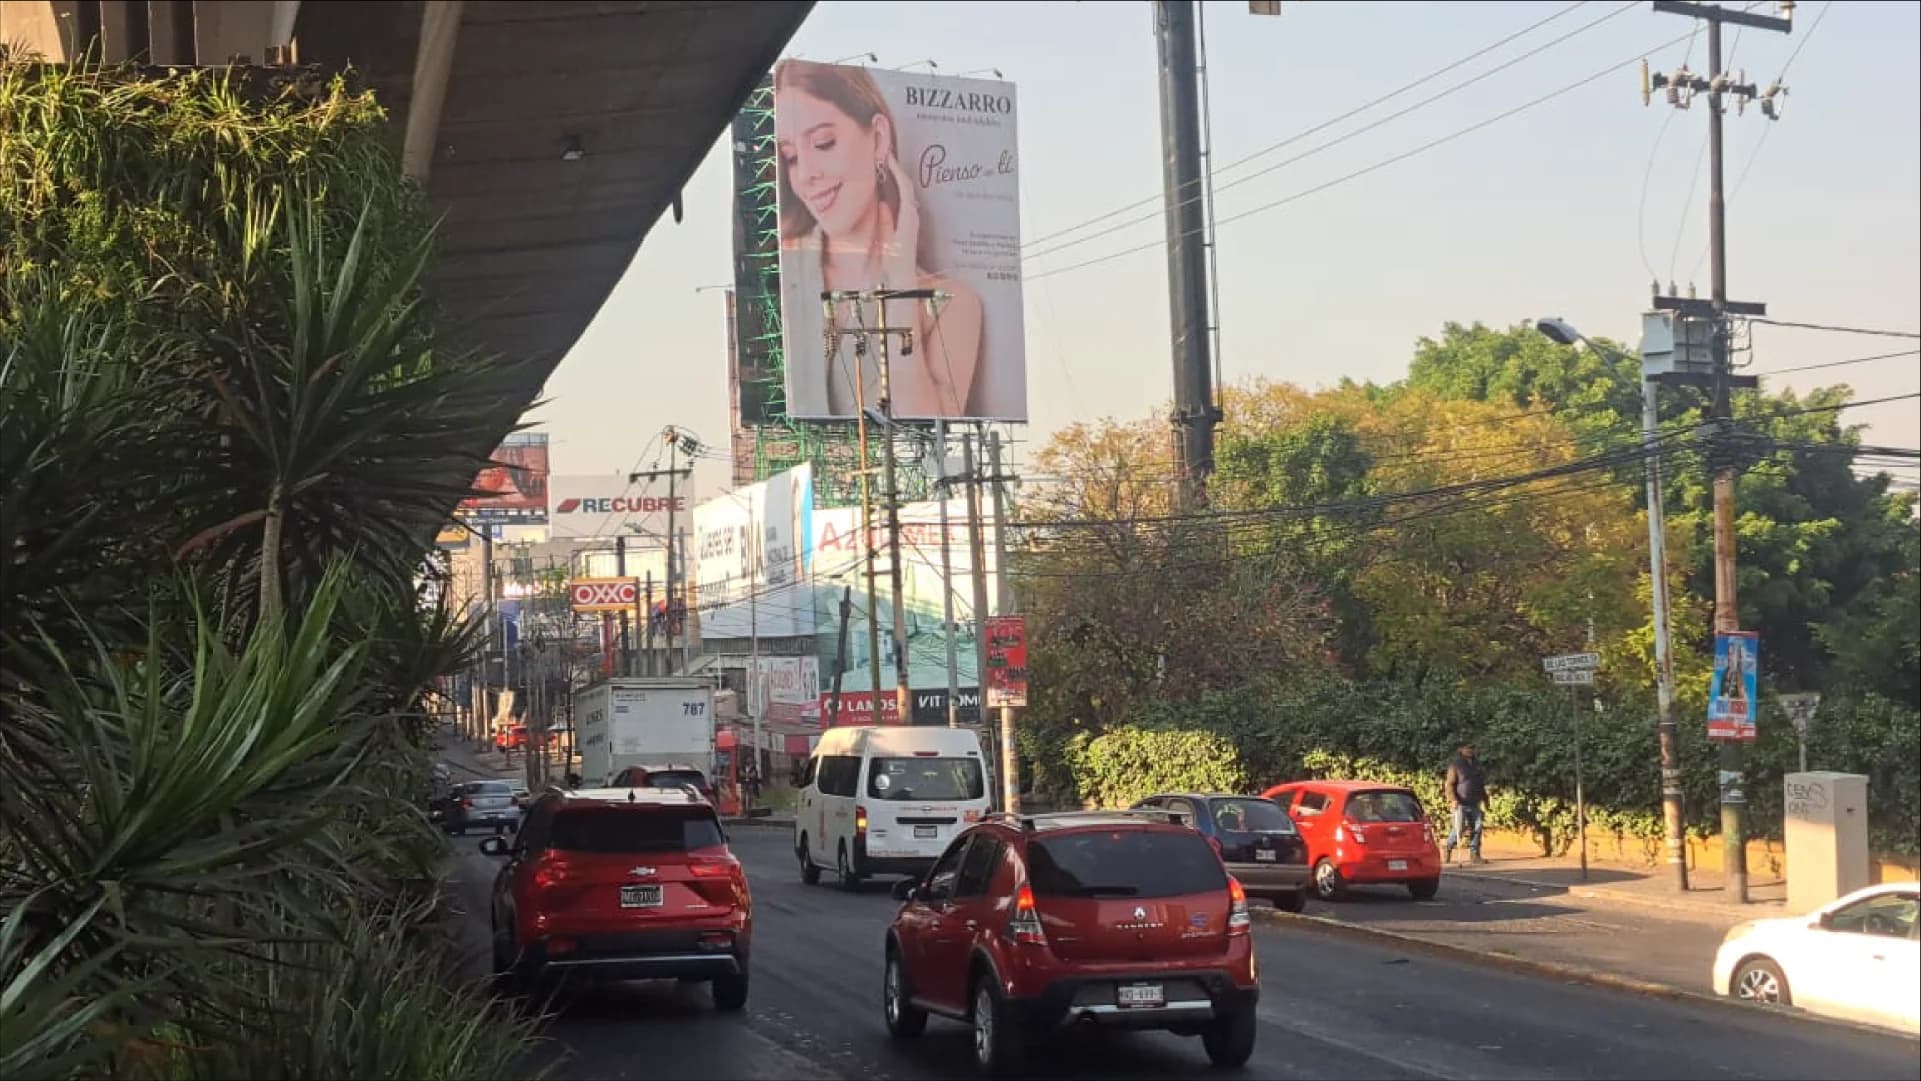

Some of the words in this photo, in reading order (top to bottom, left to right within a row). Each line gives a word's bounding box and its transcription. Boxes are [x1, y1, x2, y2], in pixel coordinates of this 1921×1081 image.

[905, 86, 1012, 114] BIZZARRO
[919, 144, 983, 188] Pienso
[582, 498, 686, 513] RECUBRE
[575, 583, 636, 605] OXXO
[682, 702, 705, 716] 787
